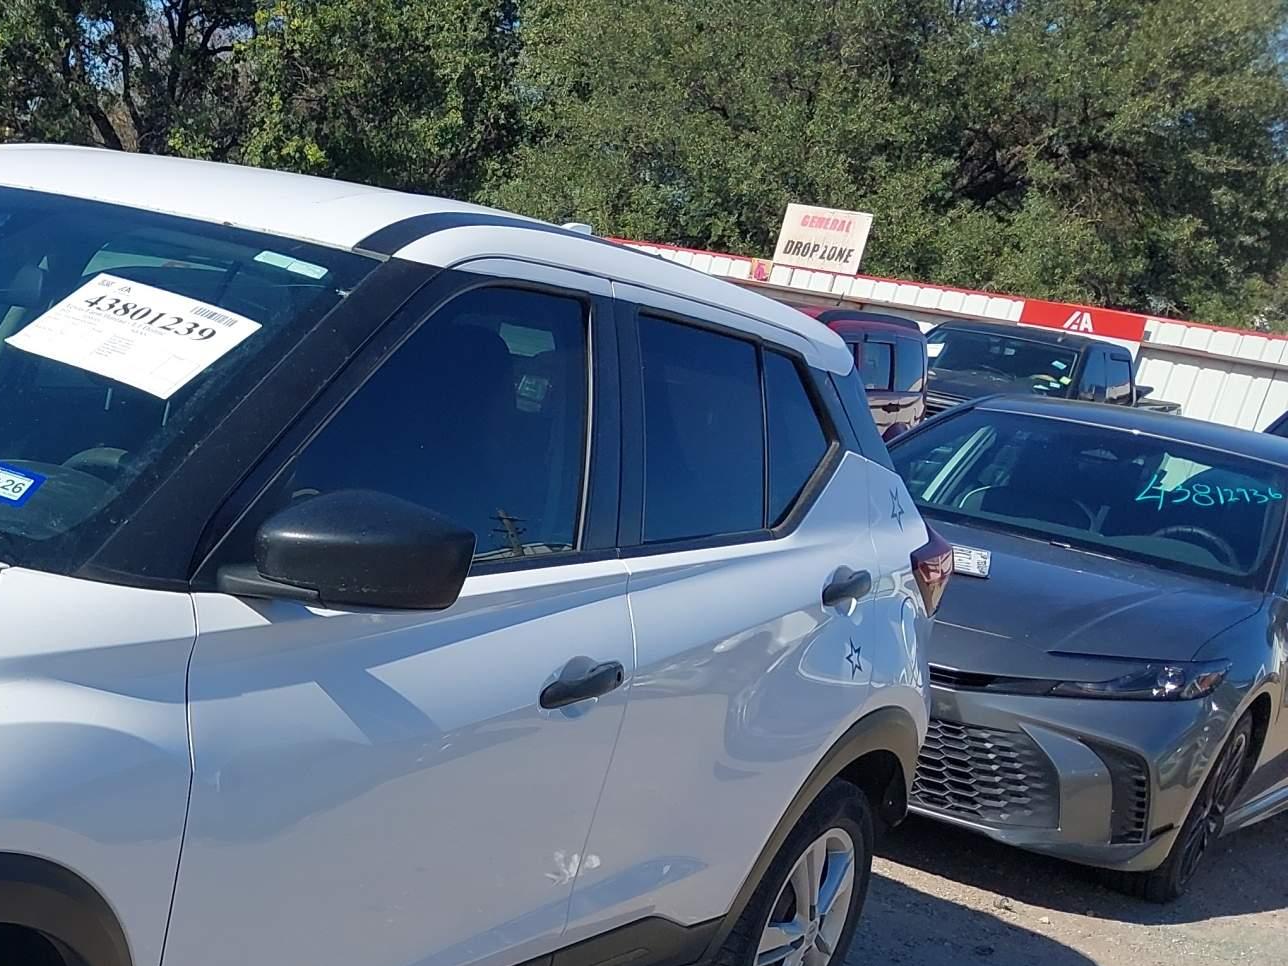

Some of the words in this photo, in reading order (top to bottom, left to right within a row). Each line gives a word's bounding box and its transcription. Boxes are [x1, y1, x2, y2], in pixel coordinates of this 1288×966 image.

[800, 214, 853, 233] GENERAL
[783, 239, 820, 259] DROP
[819, 244, 855, 264] ZONE
[84, 295, 217, 341] 43801239
